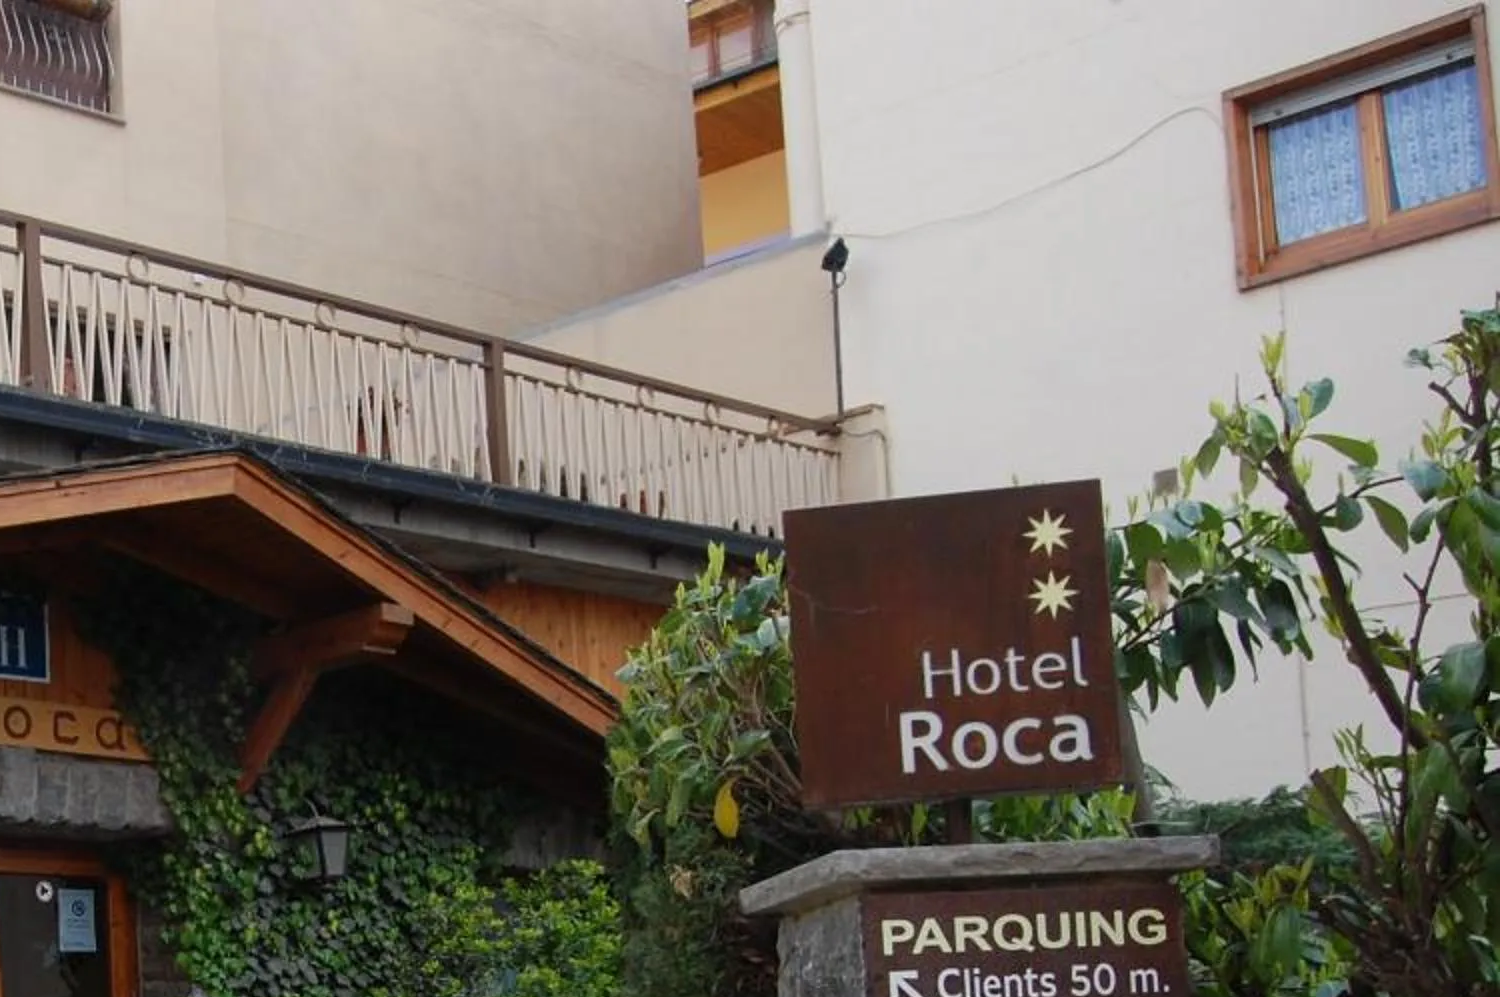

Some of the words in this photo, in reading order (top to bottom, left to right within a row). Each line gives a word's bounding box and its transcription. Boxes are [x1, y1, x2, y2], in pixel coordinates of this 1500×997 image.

[922, 636, 1089, 698] Hotel
[899, 710, 1094, 774] Roca
[880, 908, 1168, 956] PARQUING
[1070, 964, 1117, 997] 50
[1129, 969, 1171, 994] m.
